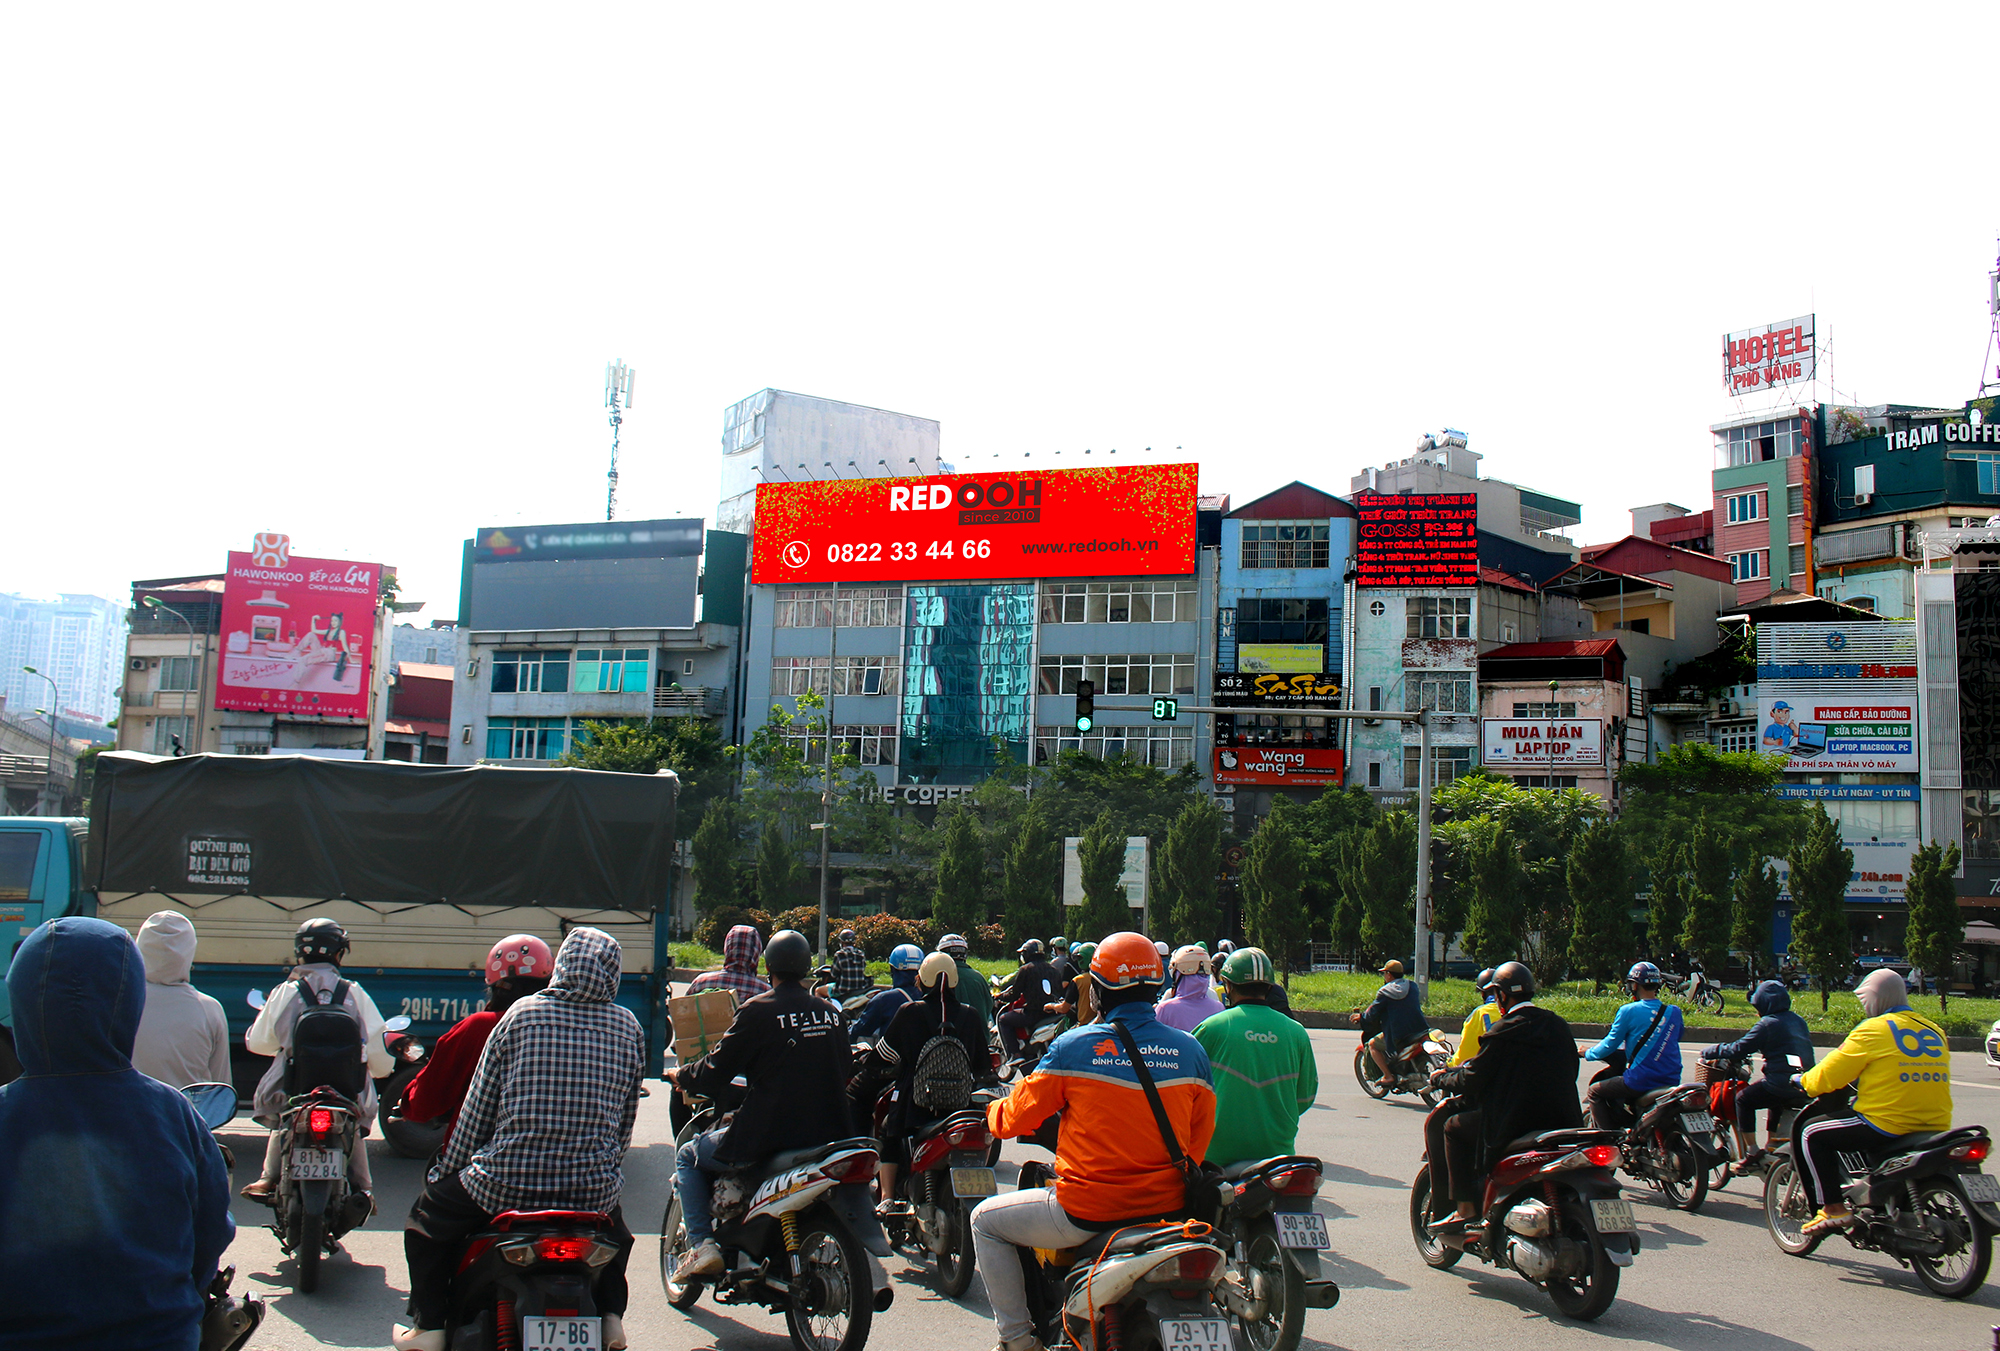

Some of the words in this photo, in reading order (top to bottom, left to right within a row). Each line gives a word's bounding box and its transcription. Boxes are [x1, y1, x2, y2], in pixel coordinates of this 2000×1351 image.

[1729, 325, 1810, 368] HOTEL
[1733, 366, 1760, 390] PHỐ
[1885, 424, 1938, 450] TRẠM
[889, 484, 952, 512] RED
[957, 480, 1042, 508] OOH
[963, 510, 1000, 523] since
[1004, 510, 1035, 522] 2010
[1439, 510, 1477, 519] TRANG
[1361, 524, 1420, 537] GOSS
[827, 542, 882, 562] 0822
[890, 542, 917, 561] 33
[925, 540, 954, 560] 44
[962, 539, 990, 559] 66
[1021, 538, 1159, 554] www.redooh.vn
[234, 568, 303, 582] HAWONKOO
[329, 586, 369, 594] HAWONKOO
[1220, 676, 1234, 687] SỐ
[1236, 679, 1242, 687] 2
[1154, 700, 1176, 718] 87
[1820, 709, 1841, 719] NÂNG
[1880, 709, 1907, 719] DƯỠNG
[1502, 727, 1540, 738] MUA
[1547, 724, 1582, 738] BÁN
[1834, 725, 1850, 735] SỬA
[1852, 725, 1875, 736] CHỮA,
[1877, 725, 1890, 735] CÀI
[1893, 727, 1908, 736] ĐẶT
[1515, 742, 1571, 754] LAPTOP
[1260, 750, 1304, 766] Wang
[1802, 760, 1816, 768] PHÍ
[1862, 759, 1875, 768] VỎ
[1877, 759, 1896, 768] MÁY
[1244, 762, 1285, 776] wang
[858, 786, 896, 804] THE
[1786, 789, 1808, 798] TRỰC
[1811, 788, 1829, 797] TIẾP
[1832, 788, 1848, 797] LẤY
[1896, 788, 1910, 797] TÍN
[229, 842, 251, 853] HOA
[1861, 872, 1902, 882] 24h.com
[1244, 1030, 1278, 1043] Grab
[1886, 1020, 1943, 1057] be
[1123, 1045, 1179, 1056] aMove
[1156, 1060, 1179, 1069] HÀNG
[1690, 1122, 1711, 1131] 1413
[300, 1152, 333, 1163] 81-01
[294, 1165, 337, 1178] 292.84
[1597, 1202, 1626, 1215] 98-H1
[1283, 1215, 1319, 1230] 90-B2
[1599, 1217, 1634, 1230] 268.59
[1283, 1231, 1326, 1246] 118.86
[538, 1322, 589, 1344] 17-B6
[1172, 1322, 1218, 1342] 29-Y7
